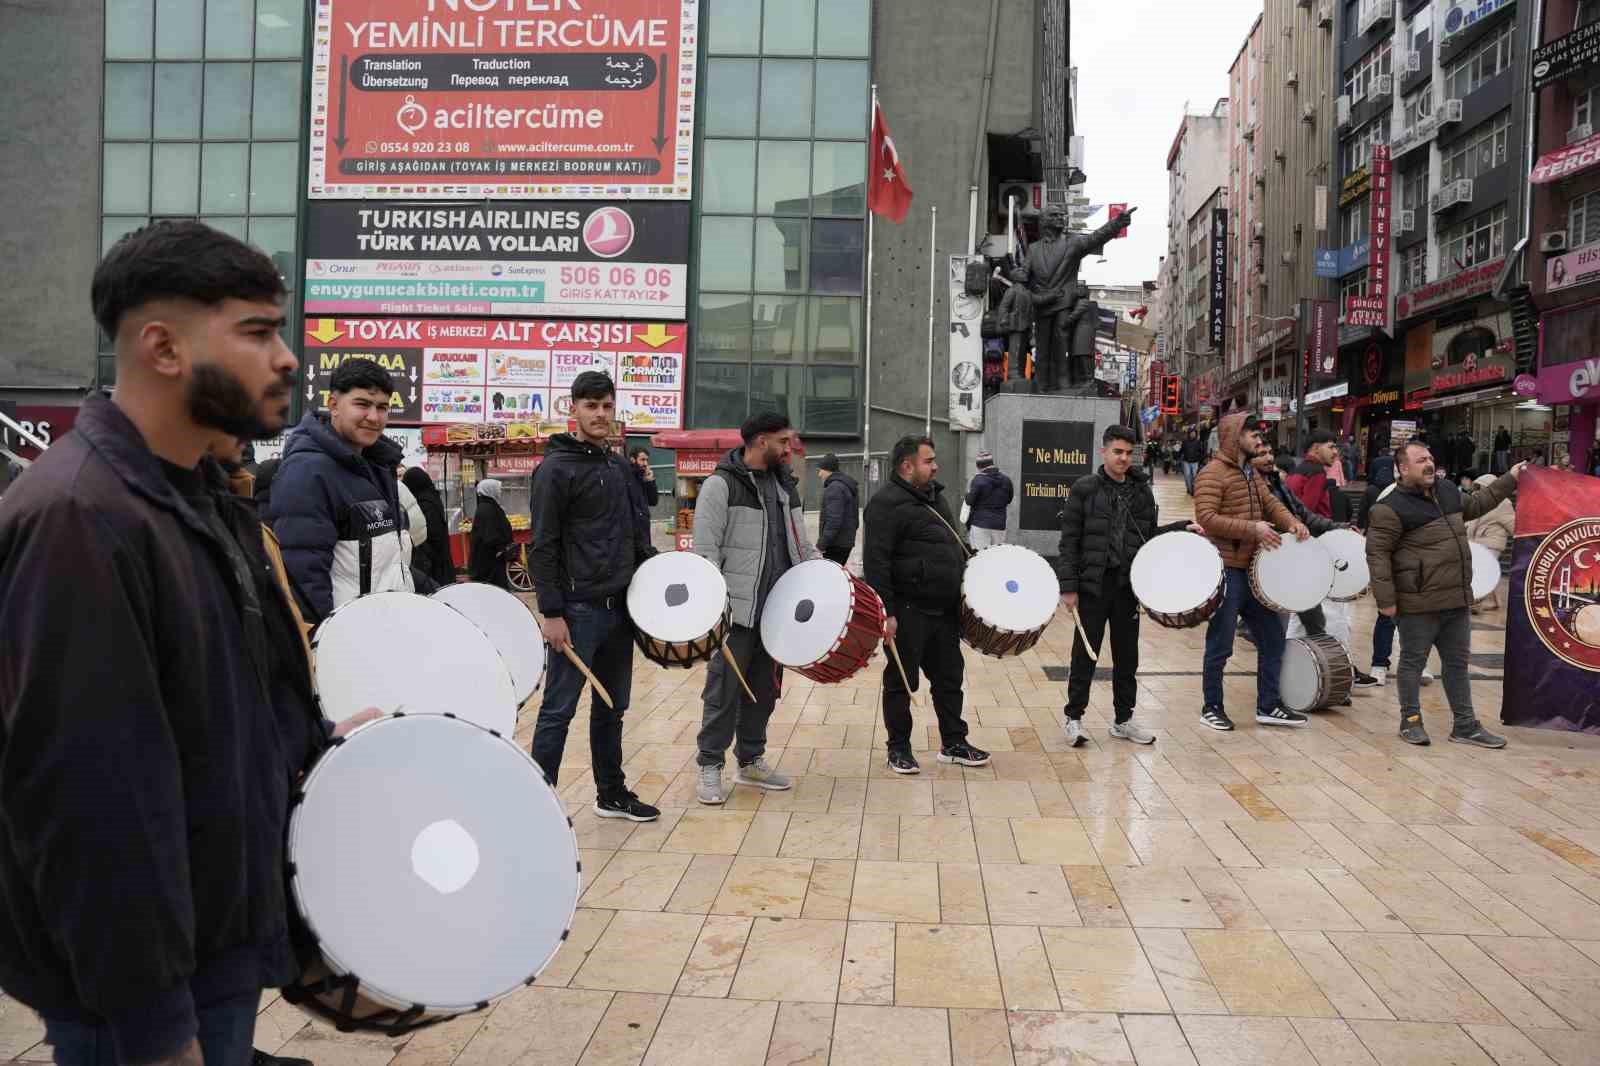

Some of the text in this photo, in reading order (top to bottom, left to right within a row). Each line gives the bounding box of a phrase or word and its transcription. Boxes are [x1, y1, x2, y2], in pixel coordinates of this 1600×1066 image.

[345, 13, 668, 48] YEMİNLİ TERCÜME
[363, 59, 421, 70] Translation
[472, 58, 531, 70] Traduction
[362, 73, 428, 88] Übersetzung
[451, 74, 569, 87] Перевод переклад
[434, 103, 604, 129] aciltercüme
[380, 142, 470, 153] 0554 920 23 08
[498, 141, 635, 153] www.aciltercume.com.tr
[356, 160, 386, 173] GİRİŞ
[450, 161, 490, 172] (TOYAK
[495, 160, 506, 173] İŞ
[510, 160, 559, 172] MERKEZİ
[564, 161, 611, 172] BODRUM
[616, 161, 642, 173] KAT)
[358, 210, 580, 230] TURKISH AIRLINES
[356, 230, 579, 253] TÜRK HAVA YOLLARI
[560, 266, 672, 287] 506 06 06
[310, 282, 538, 298] enuygunucakbileti.com.tr
[1214, 241, 1224, 341] ENGLISH PARK
[344, 320, 632, 348] TOYAK İŞ MERKEZİ ALT ÇARŞISI
[319, 353, 406, 370] MAA
[556, 352, 593, 365] TERZİ
[631, 393, 677, 407] TERZİ
[1036, 448, 1087, 464] Ne Mutlu
[1025, 482, 1056, 497] Türküm
[1532, 548, 1561, 600] İSTANBUL
